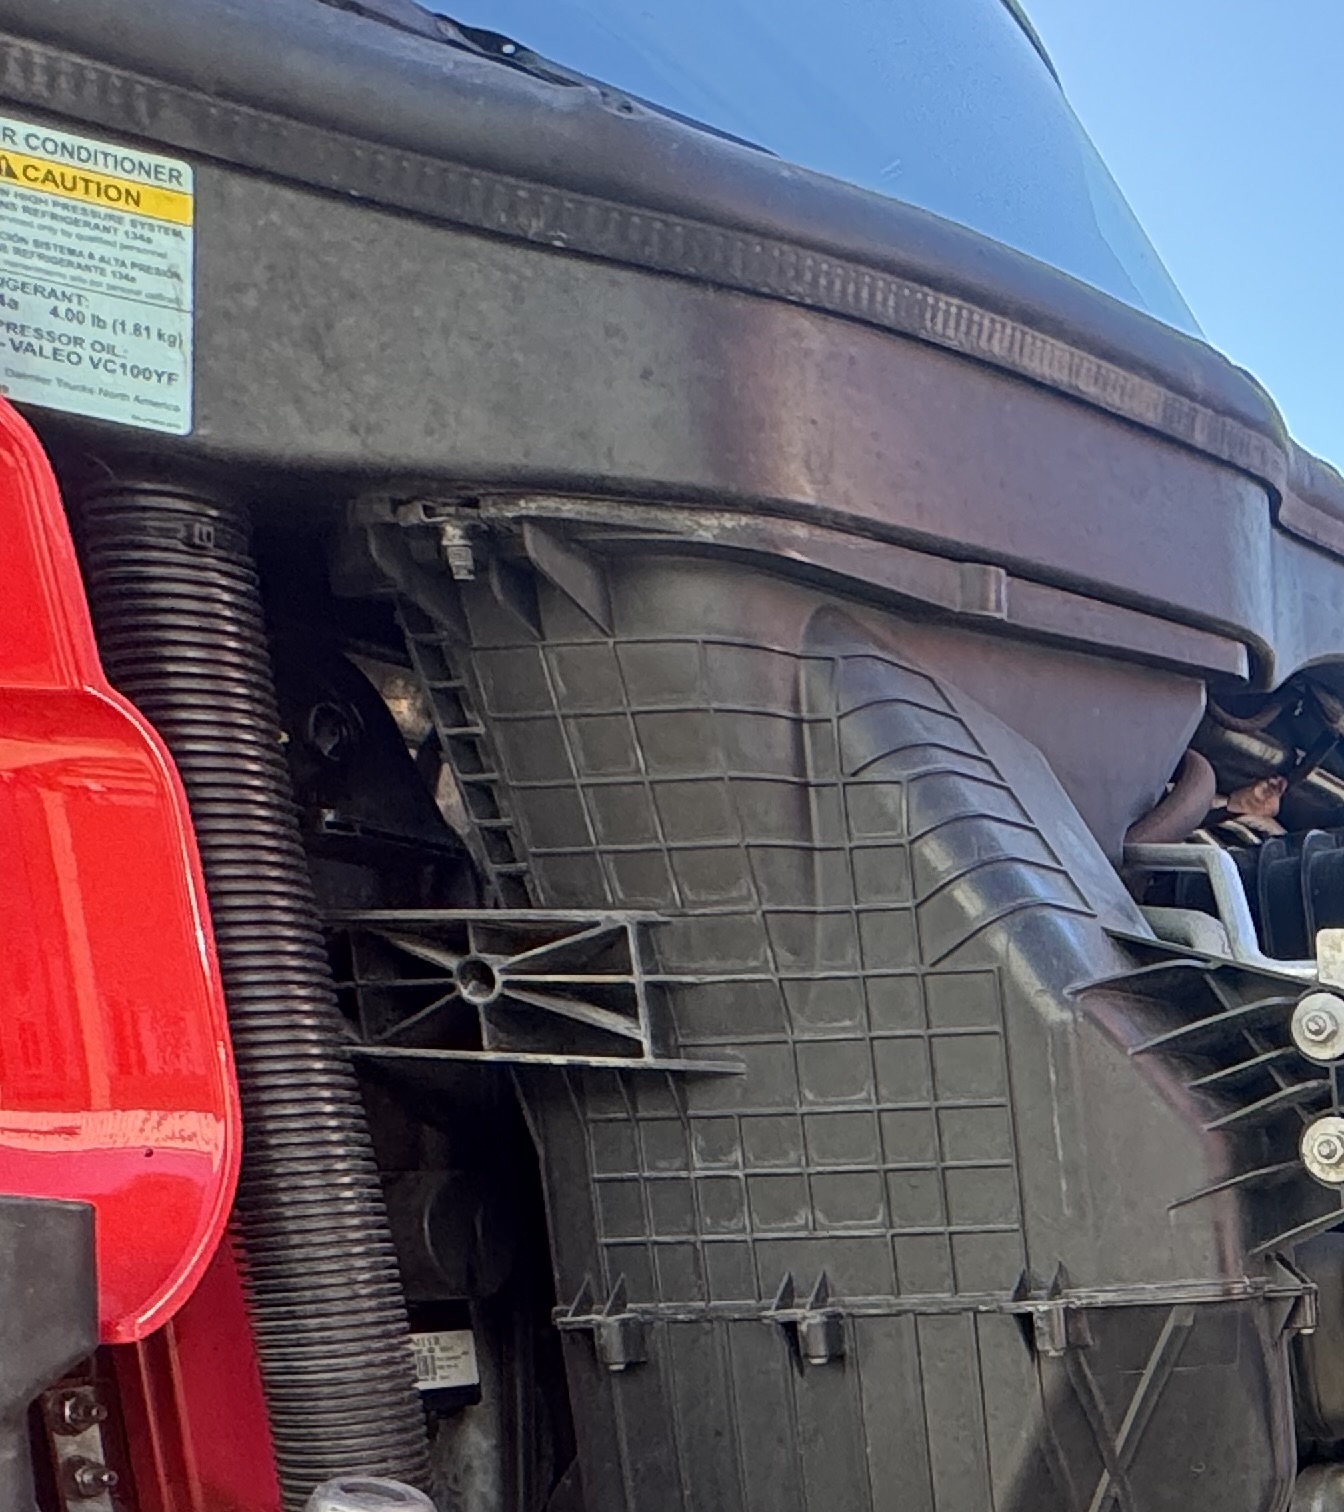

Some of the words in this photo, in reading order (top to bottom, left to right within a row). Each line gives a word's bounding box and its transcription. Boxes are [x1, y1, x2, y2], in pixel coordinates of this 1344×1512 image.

[24, 132, 184, 187] CONDITIONER
[22, 164, 142, 208] CAUTION
[21, 204, 120, 237] REFRIGERANT
[51, 199, 125, 227] PRESSURE
[0, 276, 91, 310] IGERANT:
[49, 305, 87, 326] 4.00
[91, 312, 108, 331] lb
[112, 318, 152, 341] (1.81
[157, 328, 184, 351] kg)
[9, 336, 83, 367] VALEO
[89, 354, 181, 387] VC100YF
